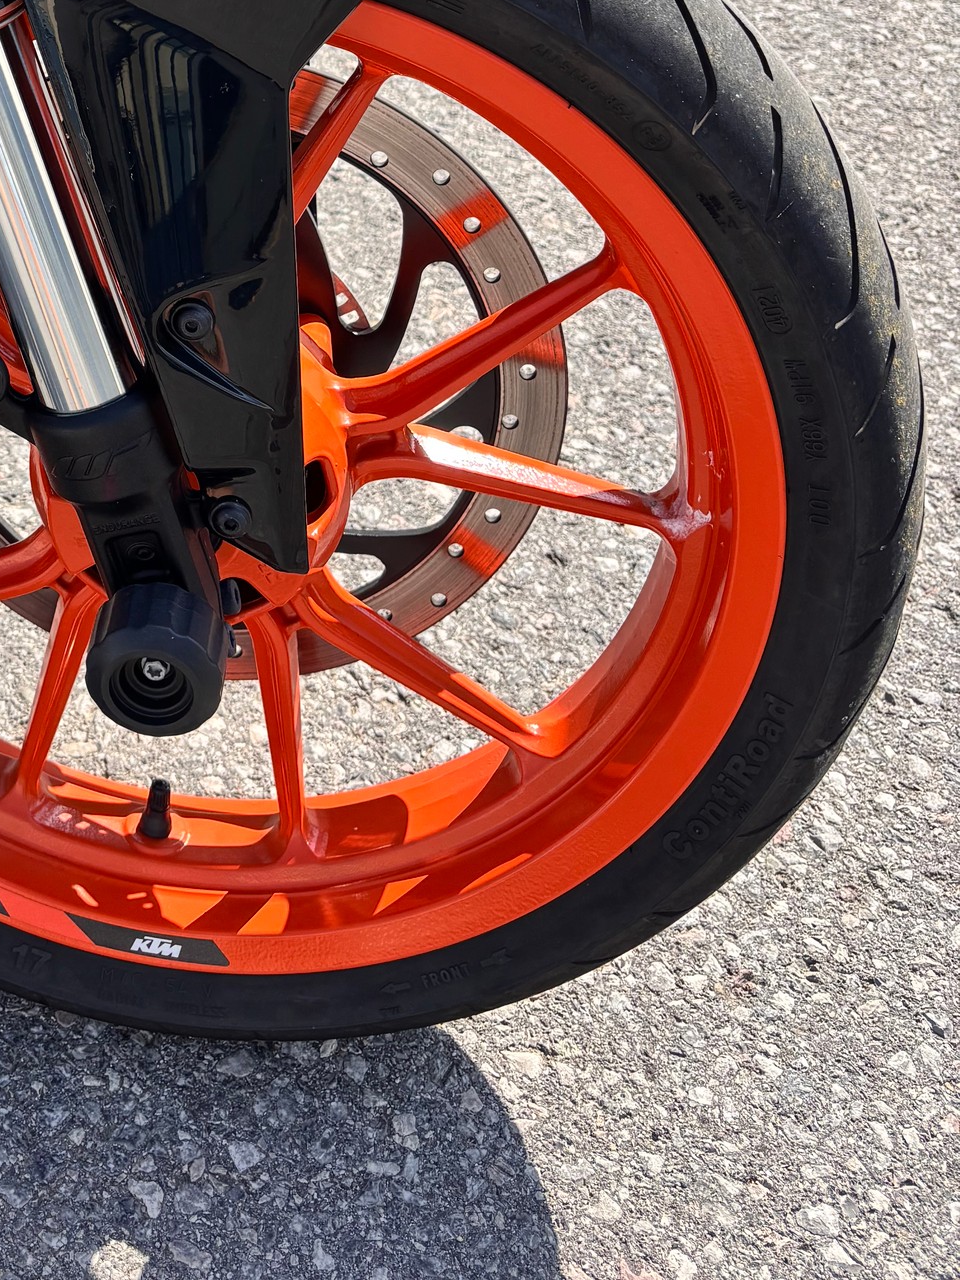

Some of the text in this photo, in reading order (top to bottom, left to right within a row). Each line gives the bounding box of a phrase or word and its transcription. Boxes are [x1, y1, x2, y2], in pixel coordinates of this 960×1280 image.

[807, 483, 832, 527] DOT
[92, 512, 161, 536] ENDURANCE
[661, 692, 795, 862] ContiRoad
[11, 942, 54, 978] 17
[129, 935, 183, 960] KTM
[419, 960, 472, 991] FRONT
